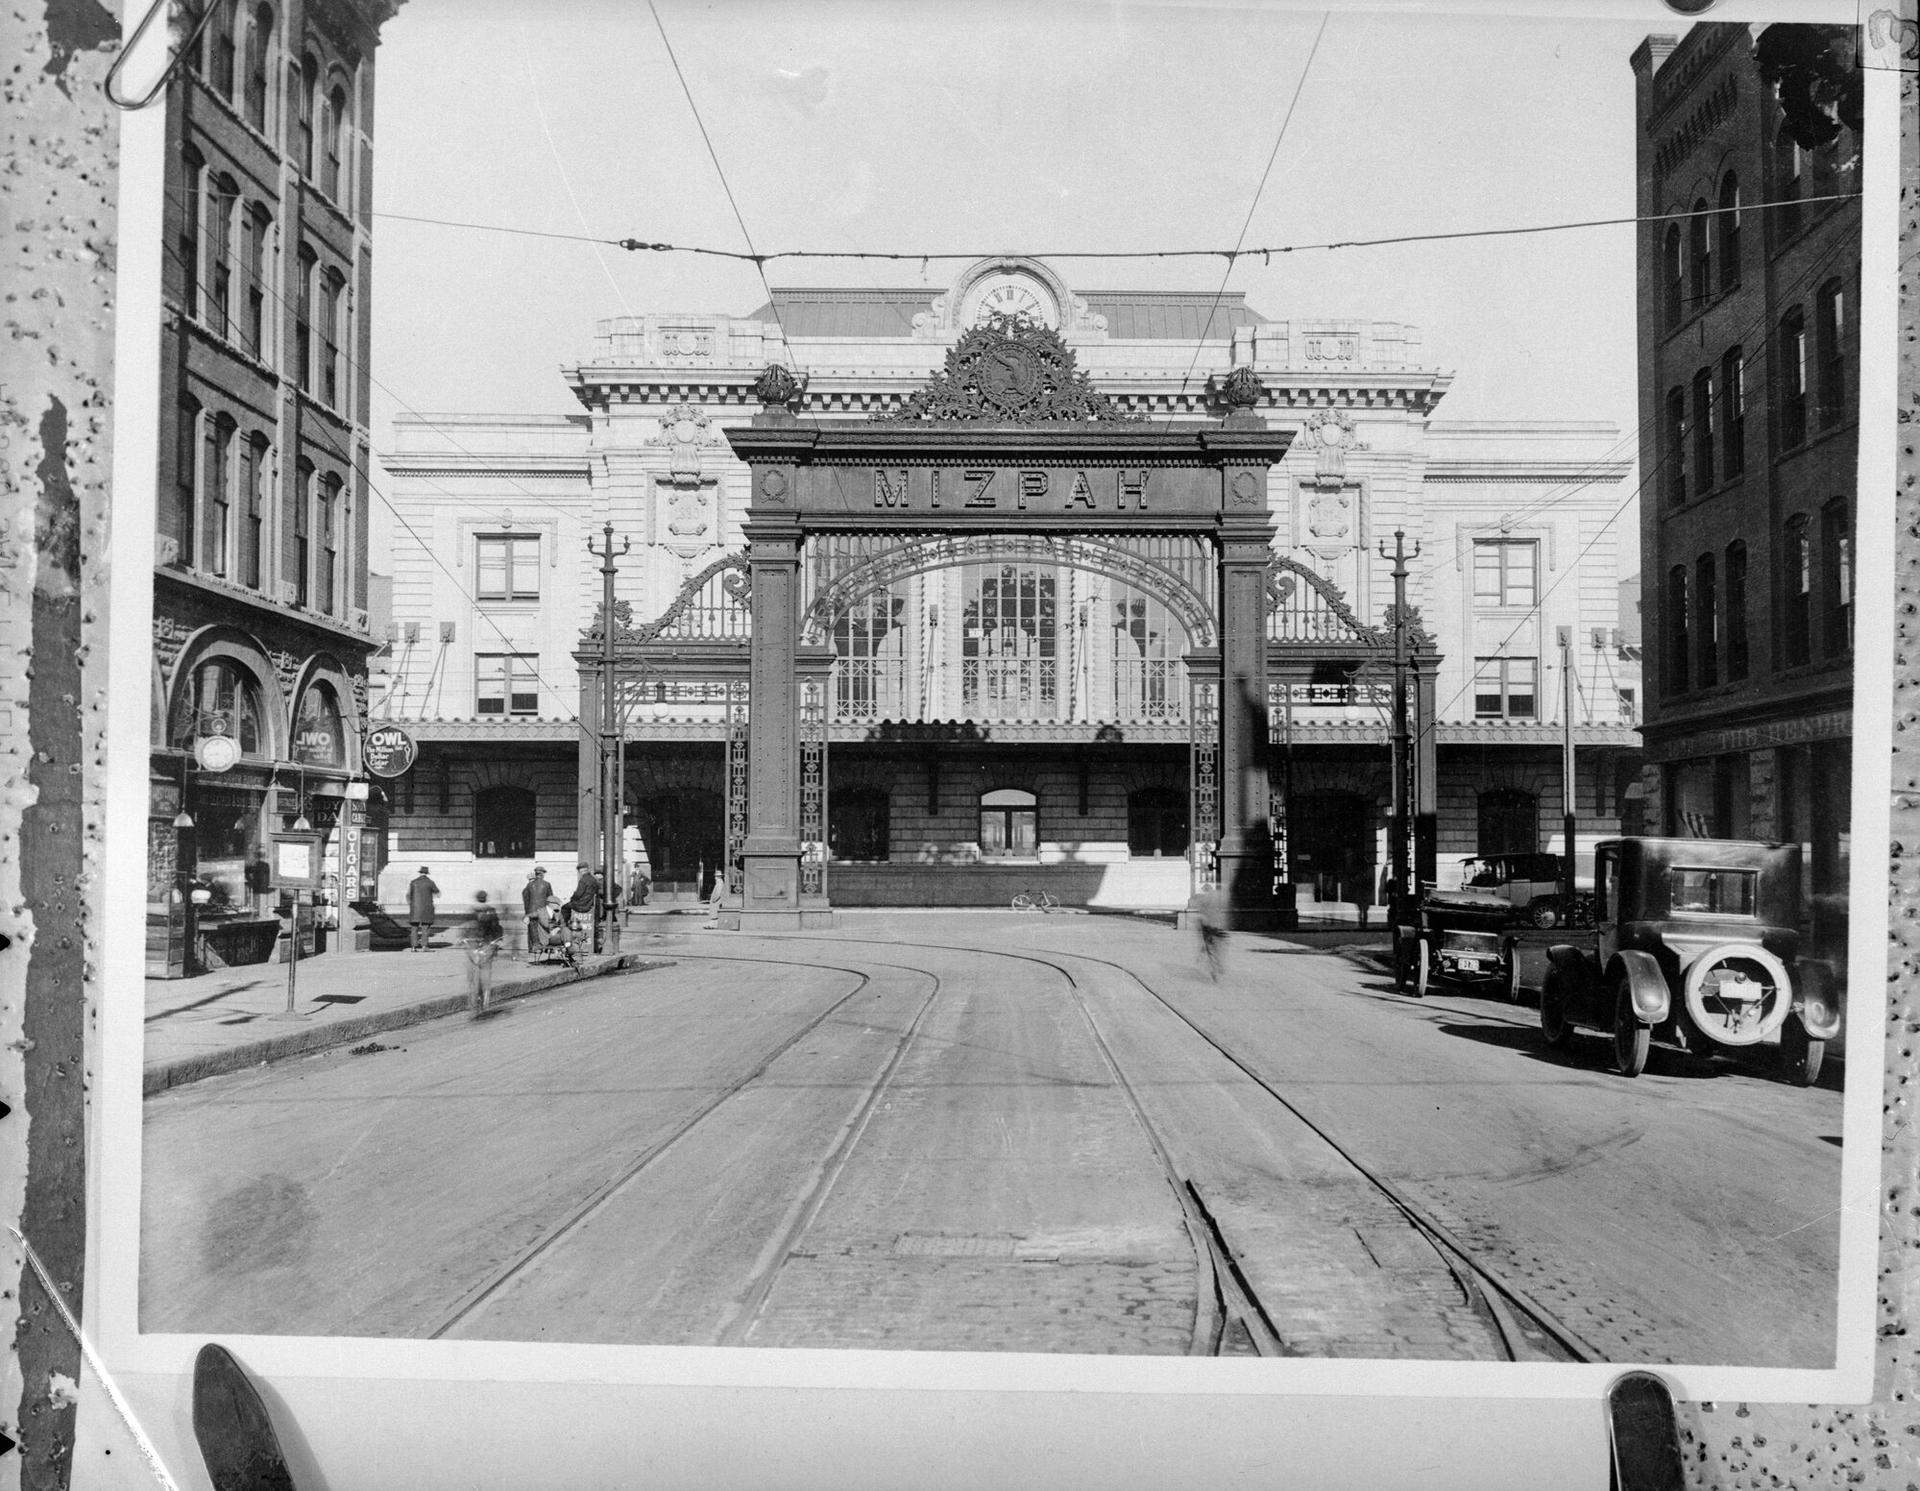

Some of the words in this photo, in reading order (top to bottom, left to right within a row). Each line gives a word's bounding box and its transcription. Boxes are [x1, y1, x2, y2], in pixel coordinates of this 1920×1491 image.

[873, 469, 1149, 509] MIZPAH
[371, 731, 407, 746] OWL
[346, 830, 358, 899] CIGARS
